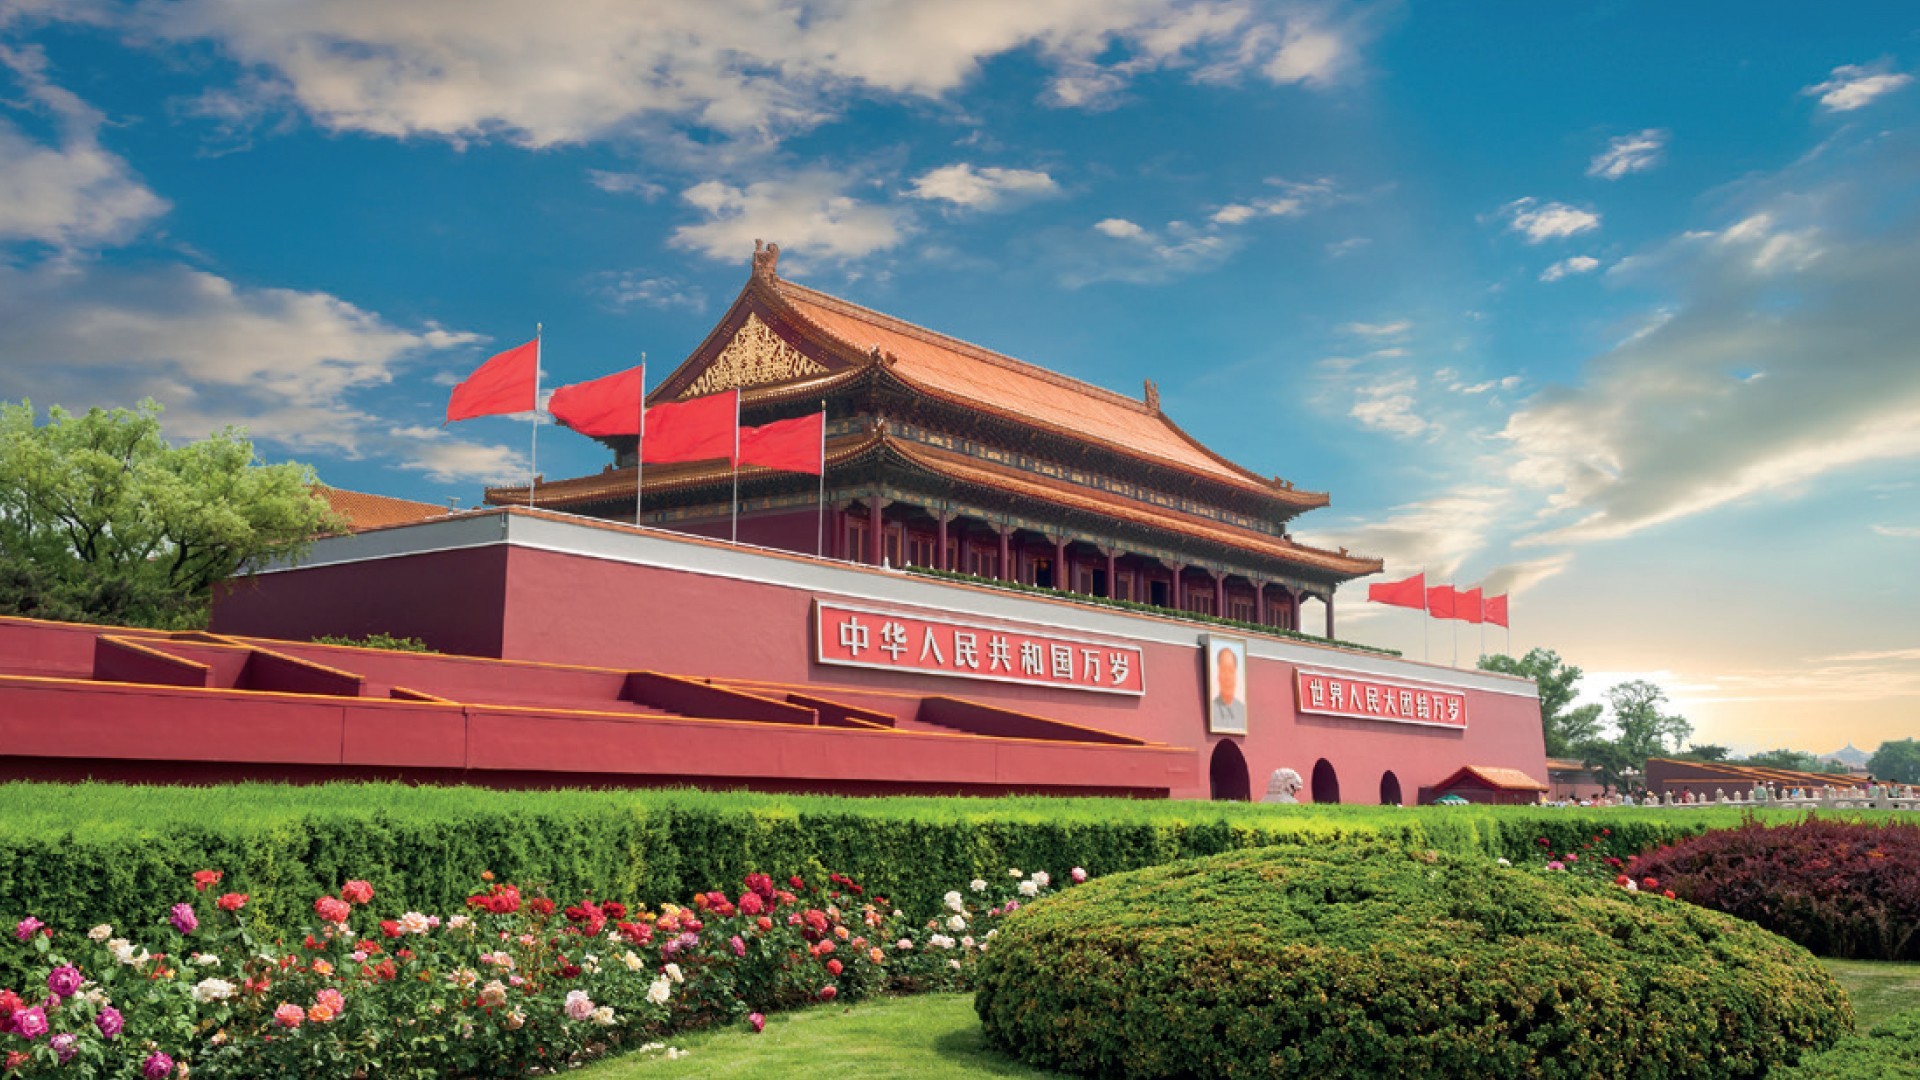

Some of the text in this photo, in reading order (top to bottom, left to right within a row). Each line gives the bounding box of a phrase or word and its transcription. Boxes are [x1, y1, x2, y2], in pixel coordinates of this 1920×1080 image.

[840, 616, 1129, 685] 中华人民共和国万岁
[1310, 678, 1459, 720] 世界人民大团结万岁
